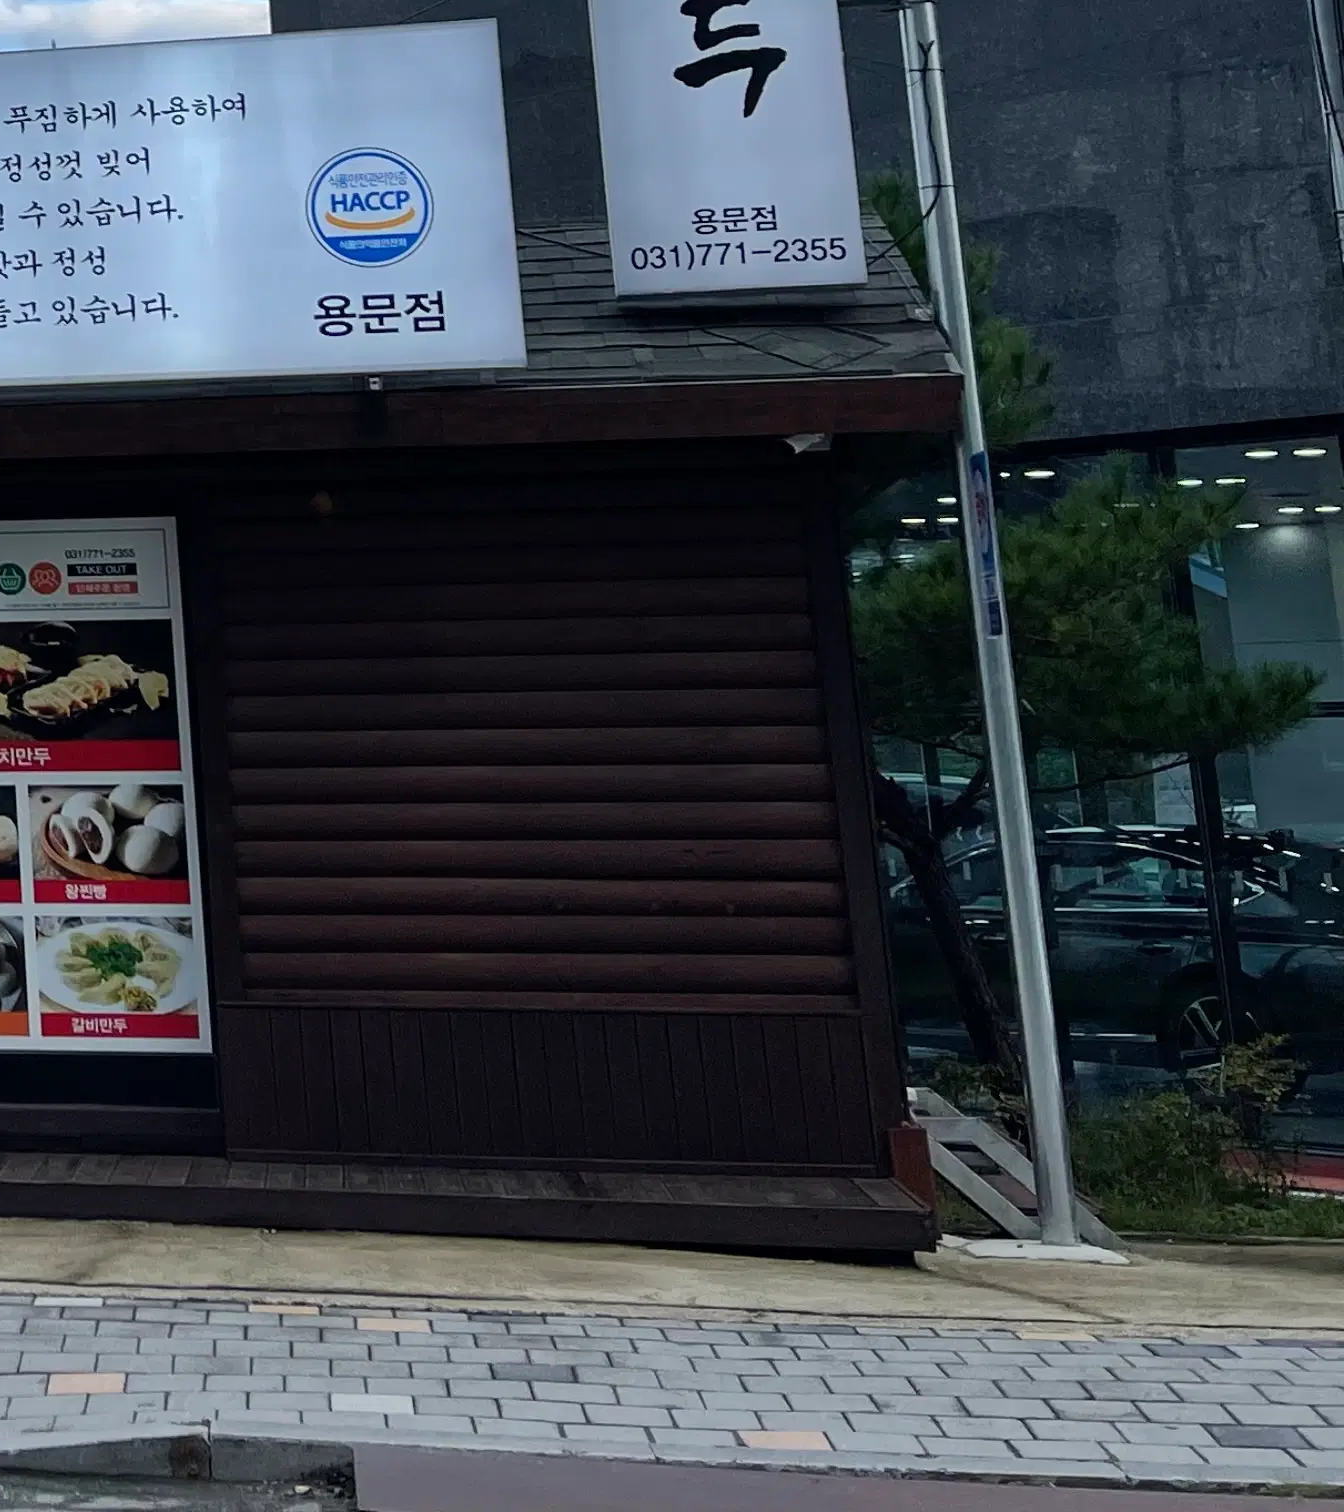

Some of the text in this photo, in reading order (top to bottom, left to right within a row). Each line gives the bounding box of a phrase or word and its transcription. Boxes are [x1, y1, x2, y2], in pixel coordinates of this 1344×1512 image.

[4, 101, 116, 133] 푸짐하게
[131, 93, 245, 125] 사용하여
[0, 151, 82, 182] 정성껏
[97, 147, 149, 176] 빚어
[18, 201, 46, 228] 수
[58, 194, 183, 227] 있습니다.
[330, 191, 410, 212] HACCP
[692, 205, 777, 234] 용문점
[53, 246, 104, 276] 정성
[631, 238, 846, 270] 031)771-2355
[52, 293, 178, 324] 있습니다.
[314, 291, 445, 336] 용문점
[65, 549, 135, 559] 031)771-2355
[75, 565, 127, 574] TAKE OUT
[65, 884, 106, 899] 왕찐빵
[72, 1018, 127, 1033] 갈비만두
